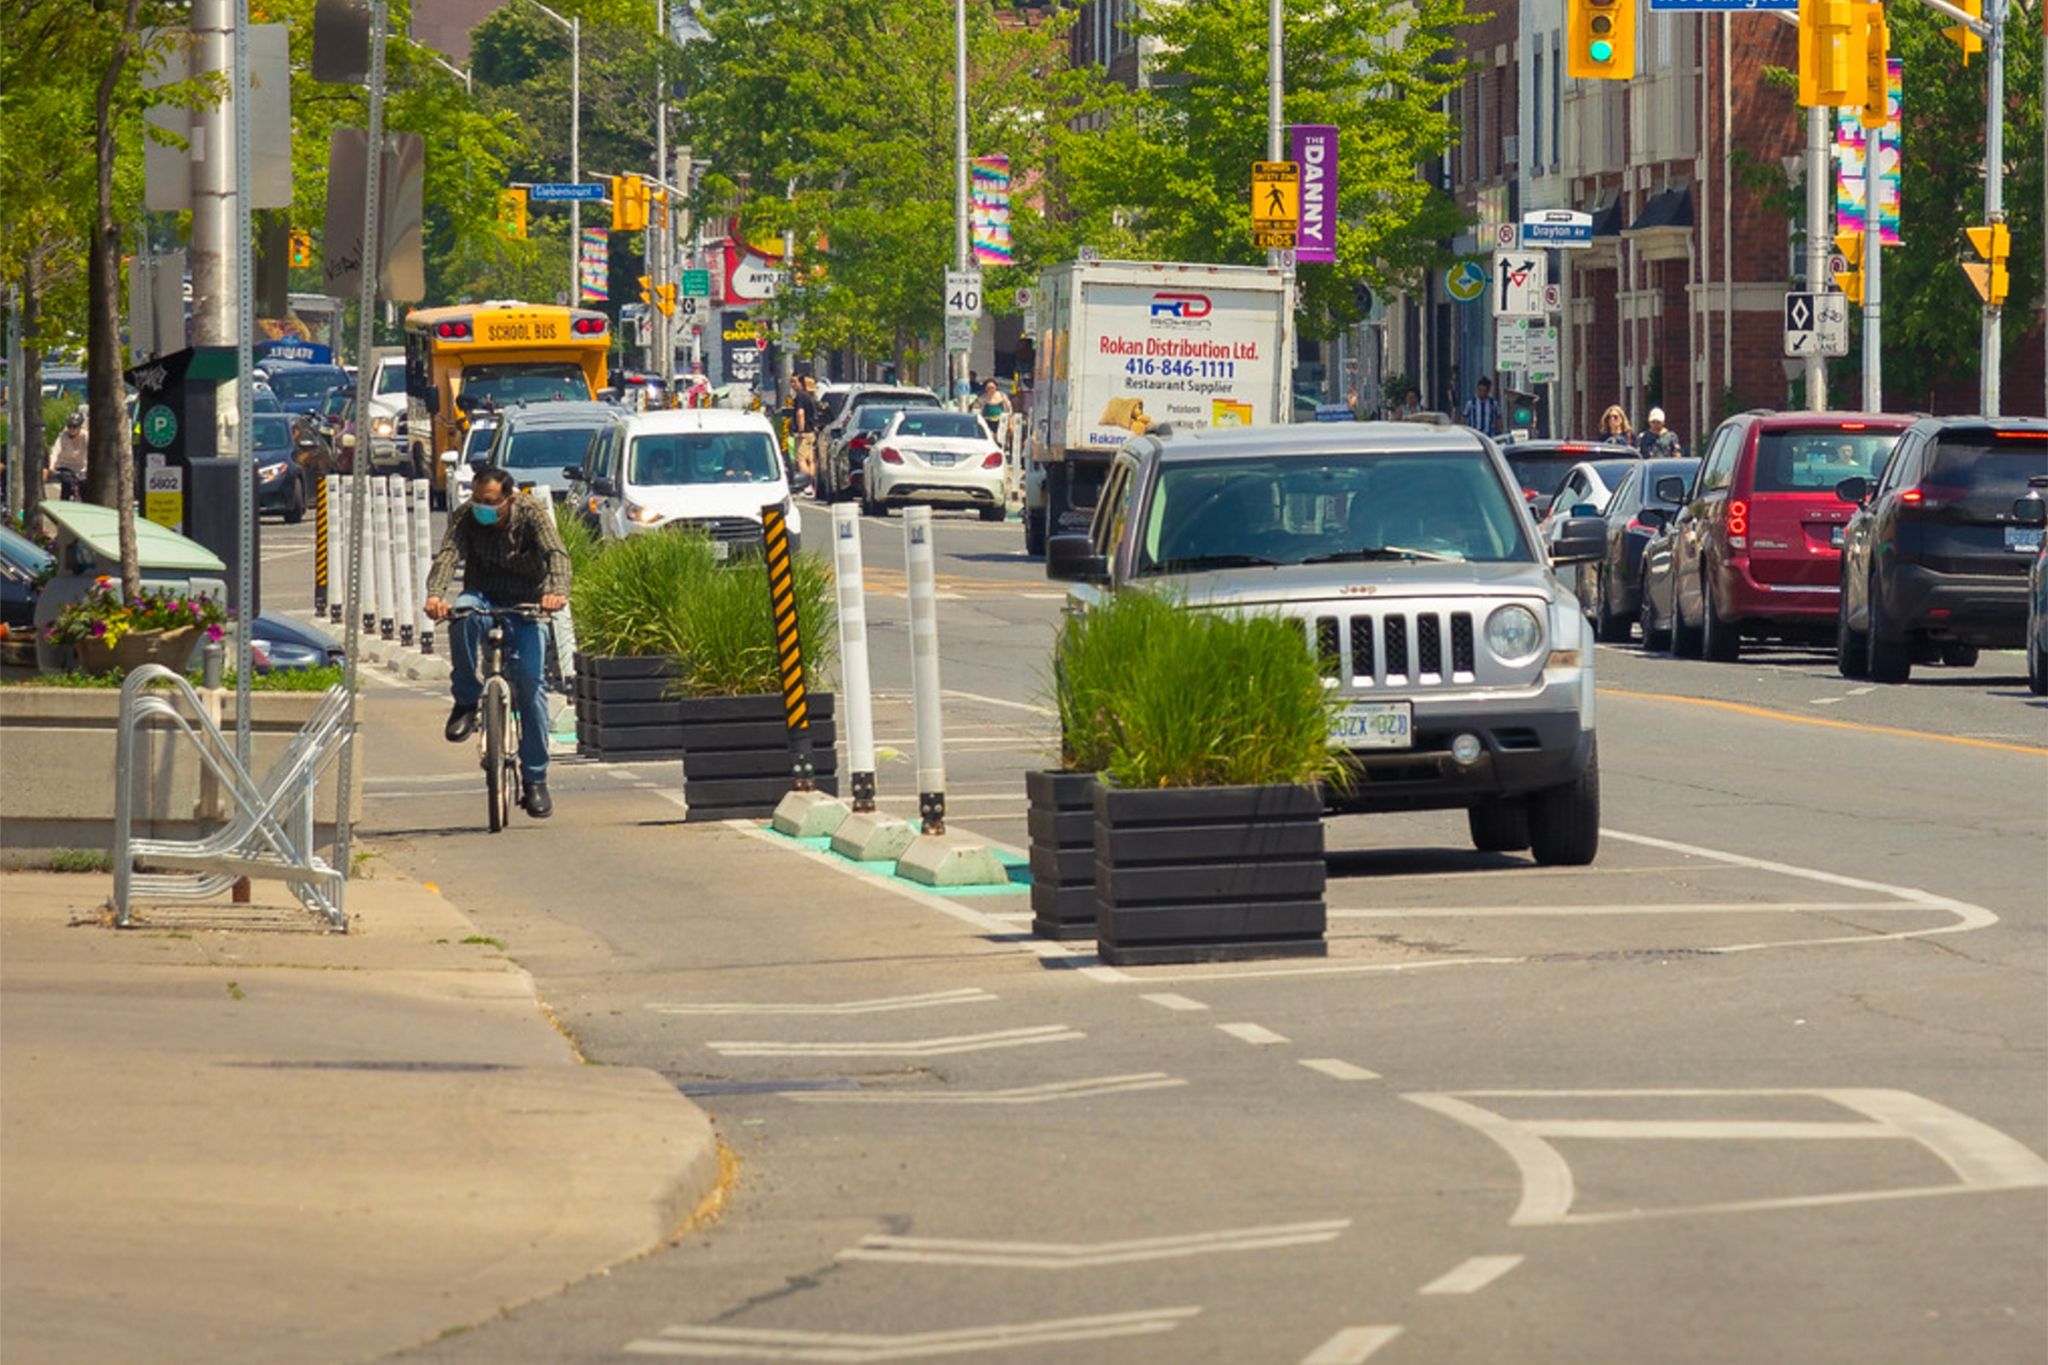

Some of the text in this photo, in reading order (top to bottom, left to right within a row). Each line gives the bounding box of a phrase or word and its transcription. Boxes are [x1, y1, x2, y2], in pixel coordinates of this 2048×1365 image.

[1305, 136, 1325, 144] THE
[1304, 145, 1325, 241] DANNY
[1259, 233, 1292, 247] ENDS
[1532, 226, 1571, 239] Drayton
[949, 290, 978, 311] 40
[488, 323, 558, 342] SCHOOL BUS
[1100, 335, 1259, 360] Rokan Distribution Ltd.
[1125, 358, 1235, 378] 416-846-1111
[1125, 377, 1233, 395] Restaurant Supplier
[149, 476, 179, 490] 5802
[1339, 585, 1376, 595] Jeep
